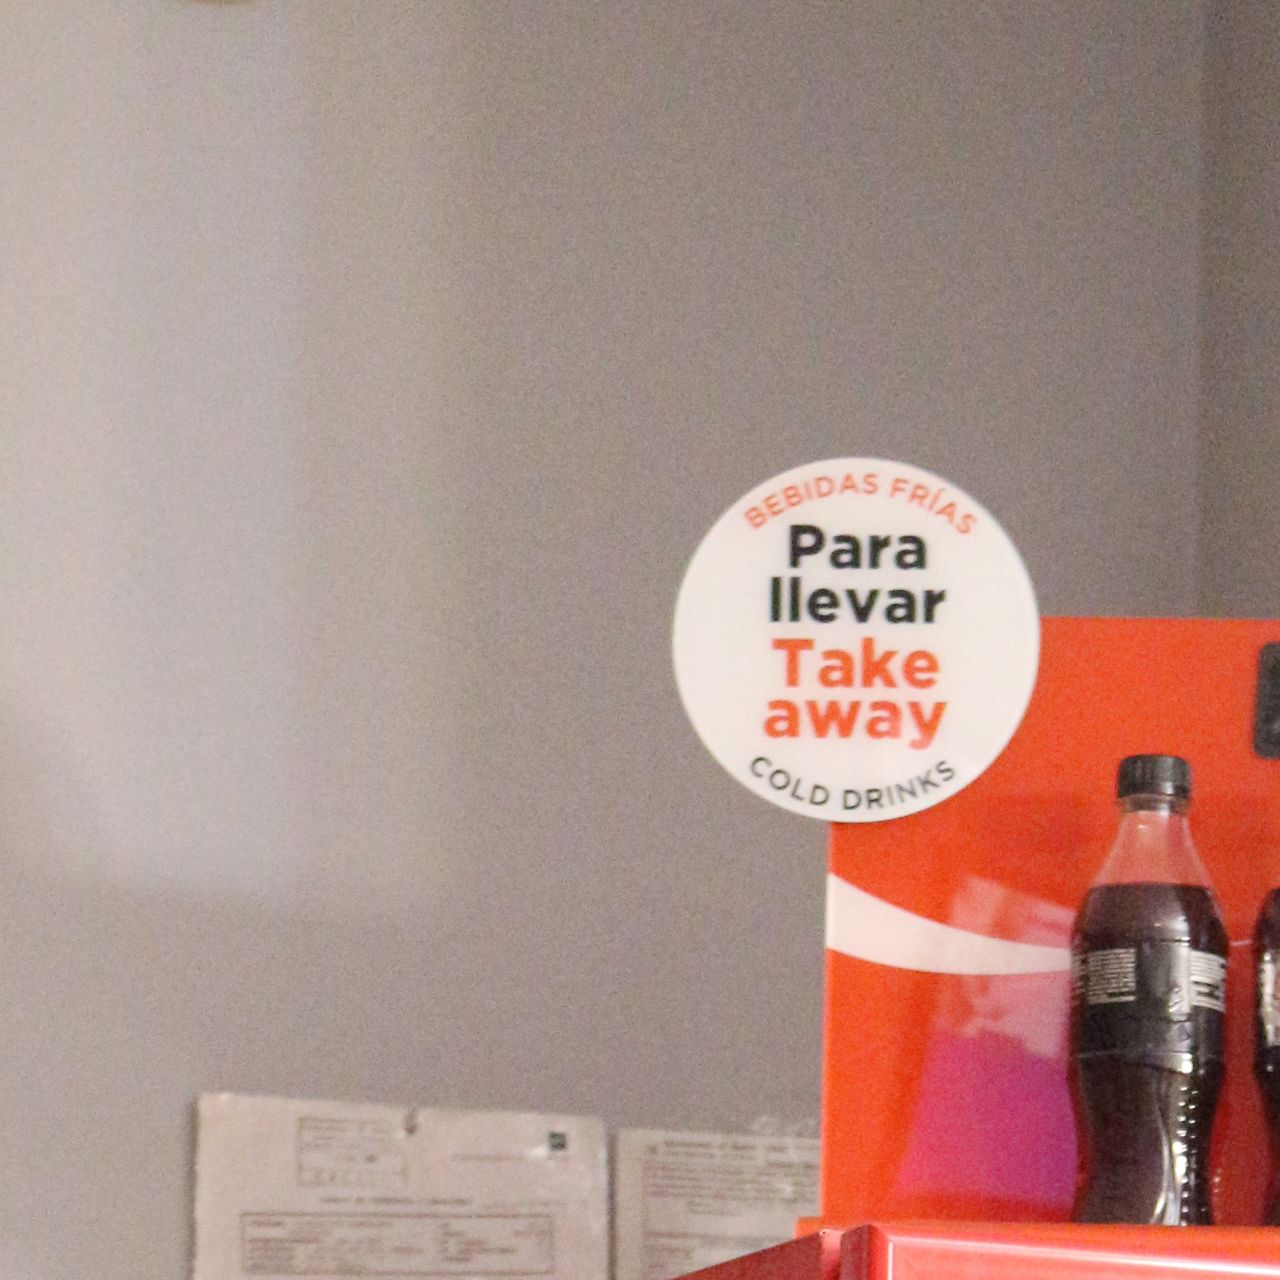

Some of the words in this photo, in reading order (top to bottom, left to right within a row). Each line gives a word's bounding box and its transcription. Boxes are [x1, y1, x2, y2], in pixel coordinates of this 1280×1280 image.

[744, 473, 878, 530] BEBIDAS
[890, 477, 977, 534] FRÍAS
[789, 524, 927, 570] Para
[768, 576, 947, 623] llevar
[772, 637, 939, 689] Take
[763, 700, 947, 750] away
[750, 756, 829, 806] COLD
[842, 760, 955, 811] DRINKS
